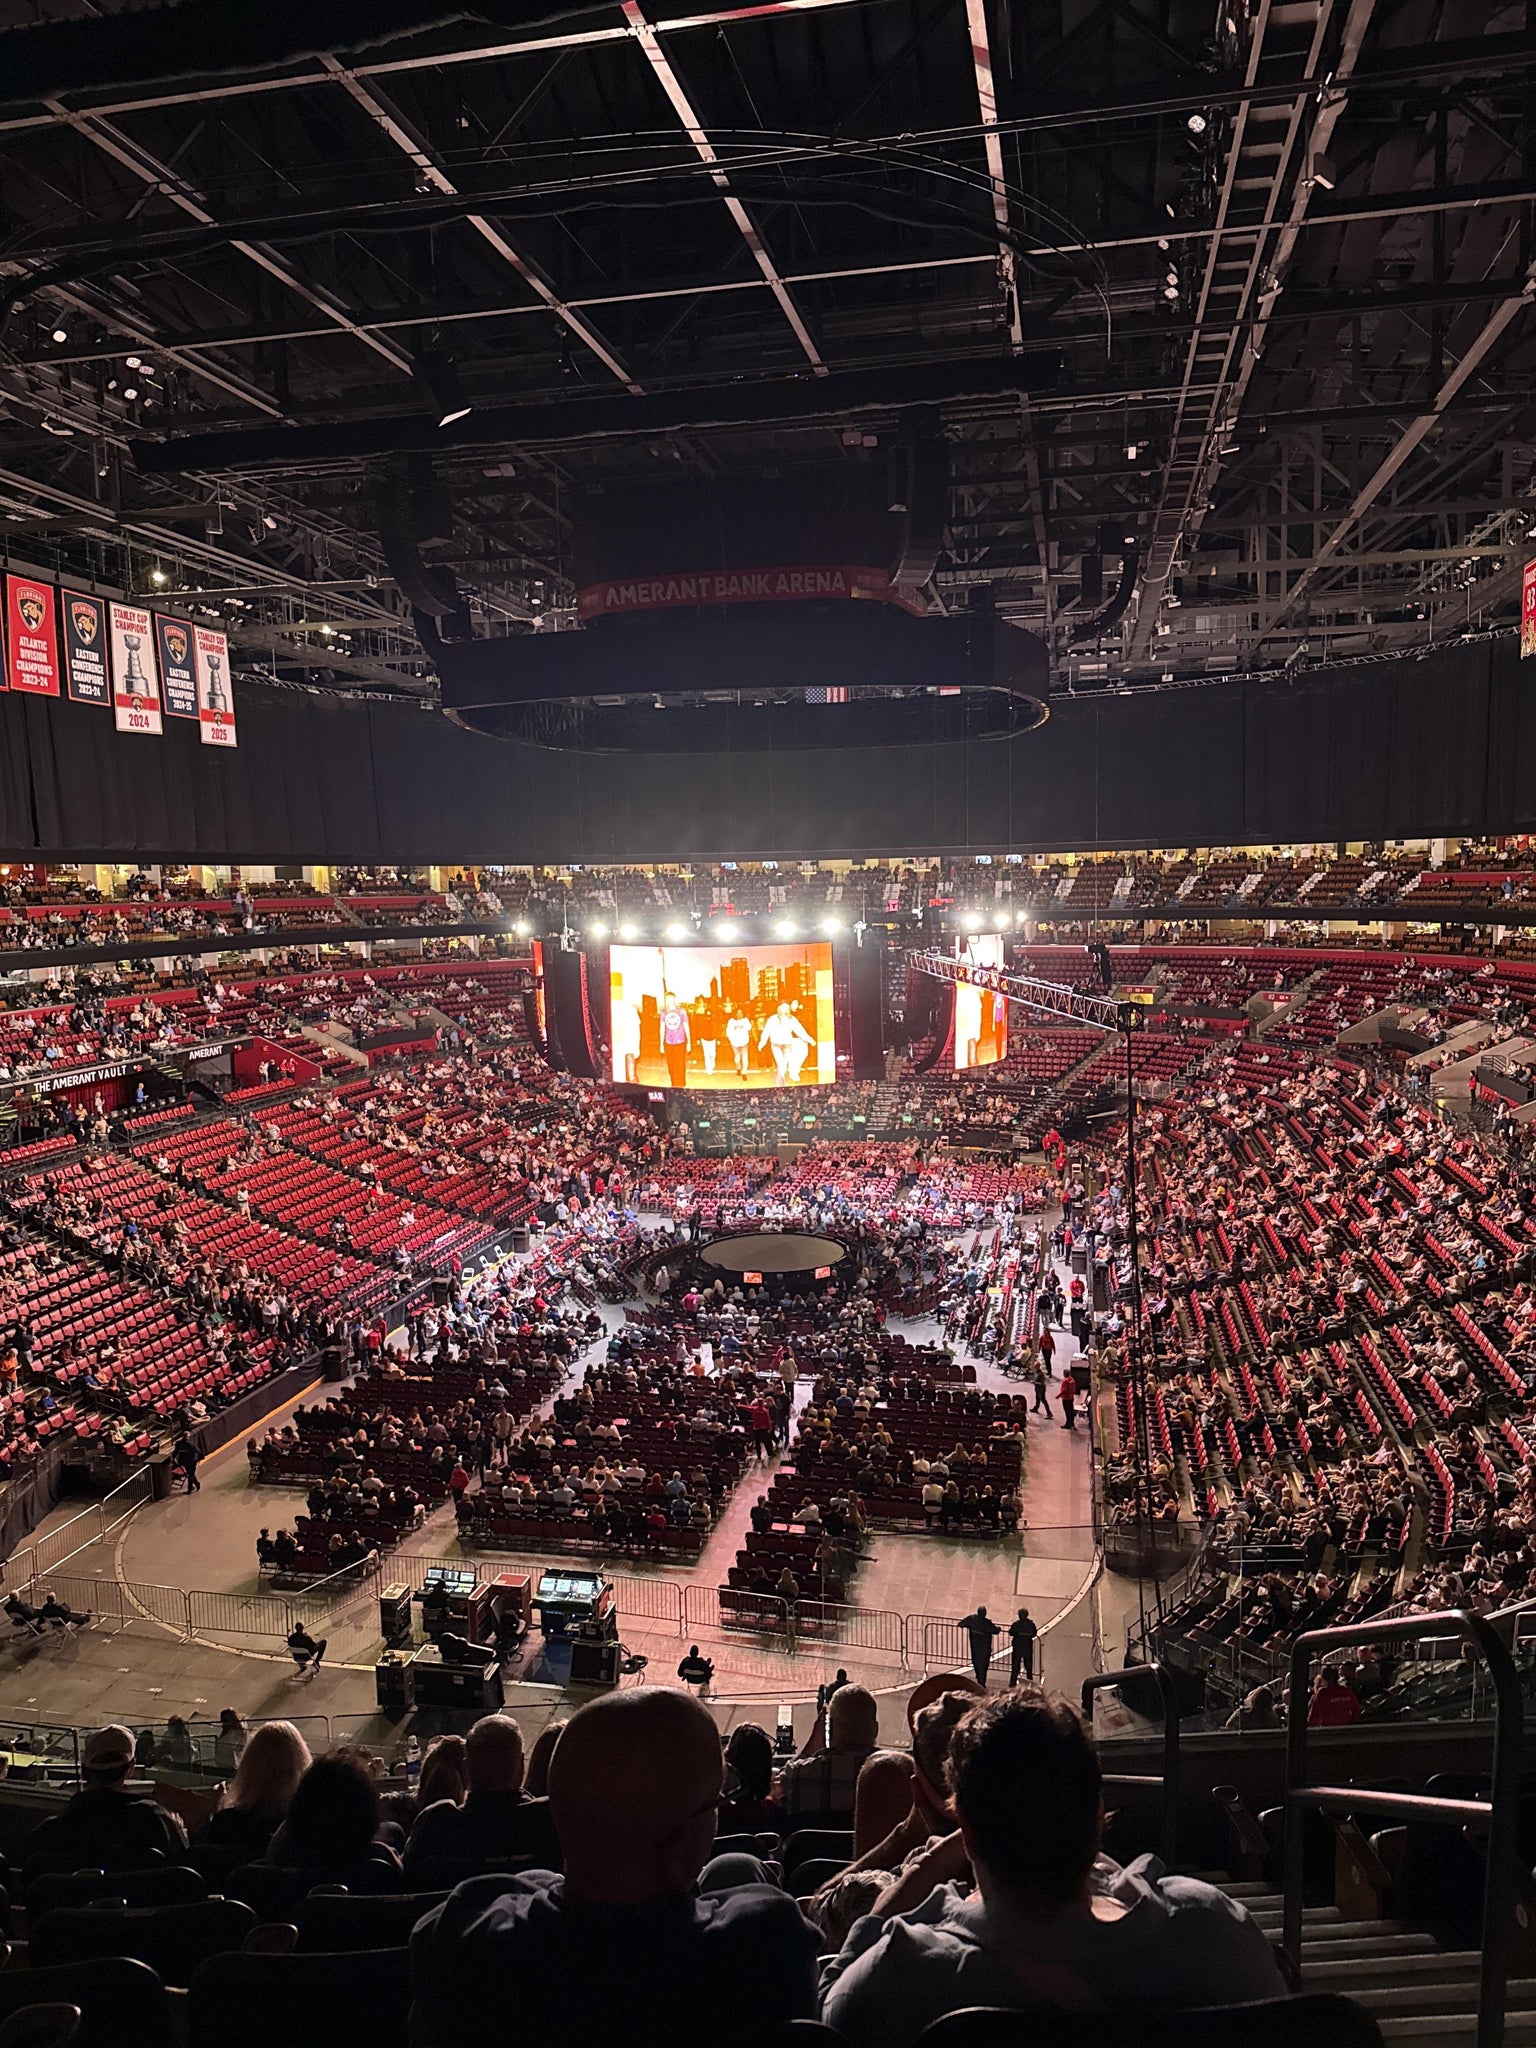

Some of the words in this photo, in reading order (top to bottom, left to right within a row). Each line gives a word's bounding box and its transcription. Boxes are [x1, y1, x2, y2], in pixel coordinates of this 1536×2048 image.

[606, 578, 711, 606] AMERANT
[715, 574, 770, 596] BANK
[775, 571, 846, 594] ARENA
[113, 608, 136, 622] STANLEY
[137, 613, 148, 624] CUP
[115, 619, 148, 635] CHAMPIONS
[19, 636, 48, 651] ATLANTIC
[20, 648, 48, 663] DIVISION
[75, 648, 99, 662] EASTERN
[16, 660, 53, 676] CHAMPIONS
[71, 659, 104, 675] CONFERENCE
[72, 671, 104, 686] CHAMPIONS
[129, 714, 150, 728] 2024
[211, 728, 228, 740] 2025
[188, 1045, 224, 1060] AMERANT
[33, 1080, 51, 1093] THE
[52, 1070, 96, 1090] AMERANT
[98, 1064, 127, 1083] VAULT
